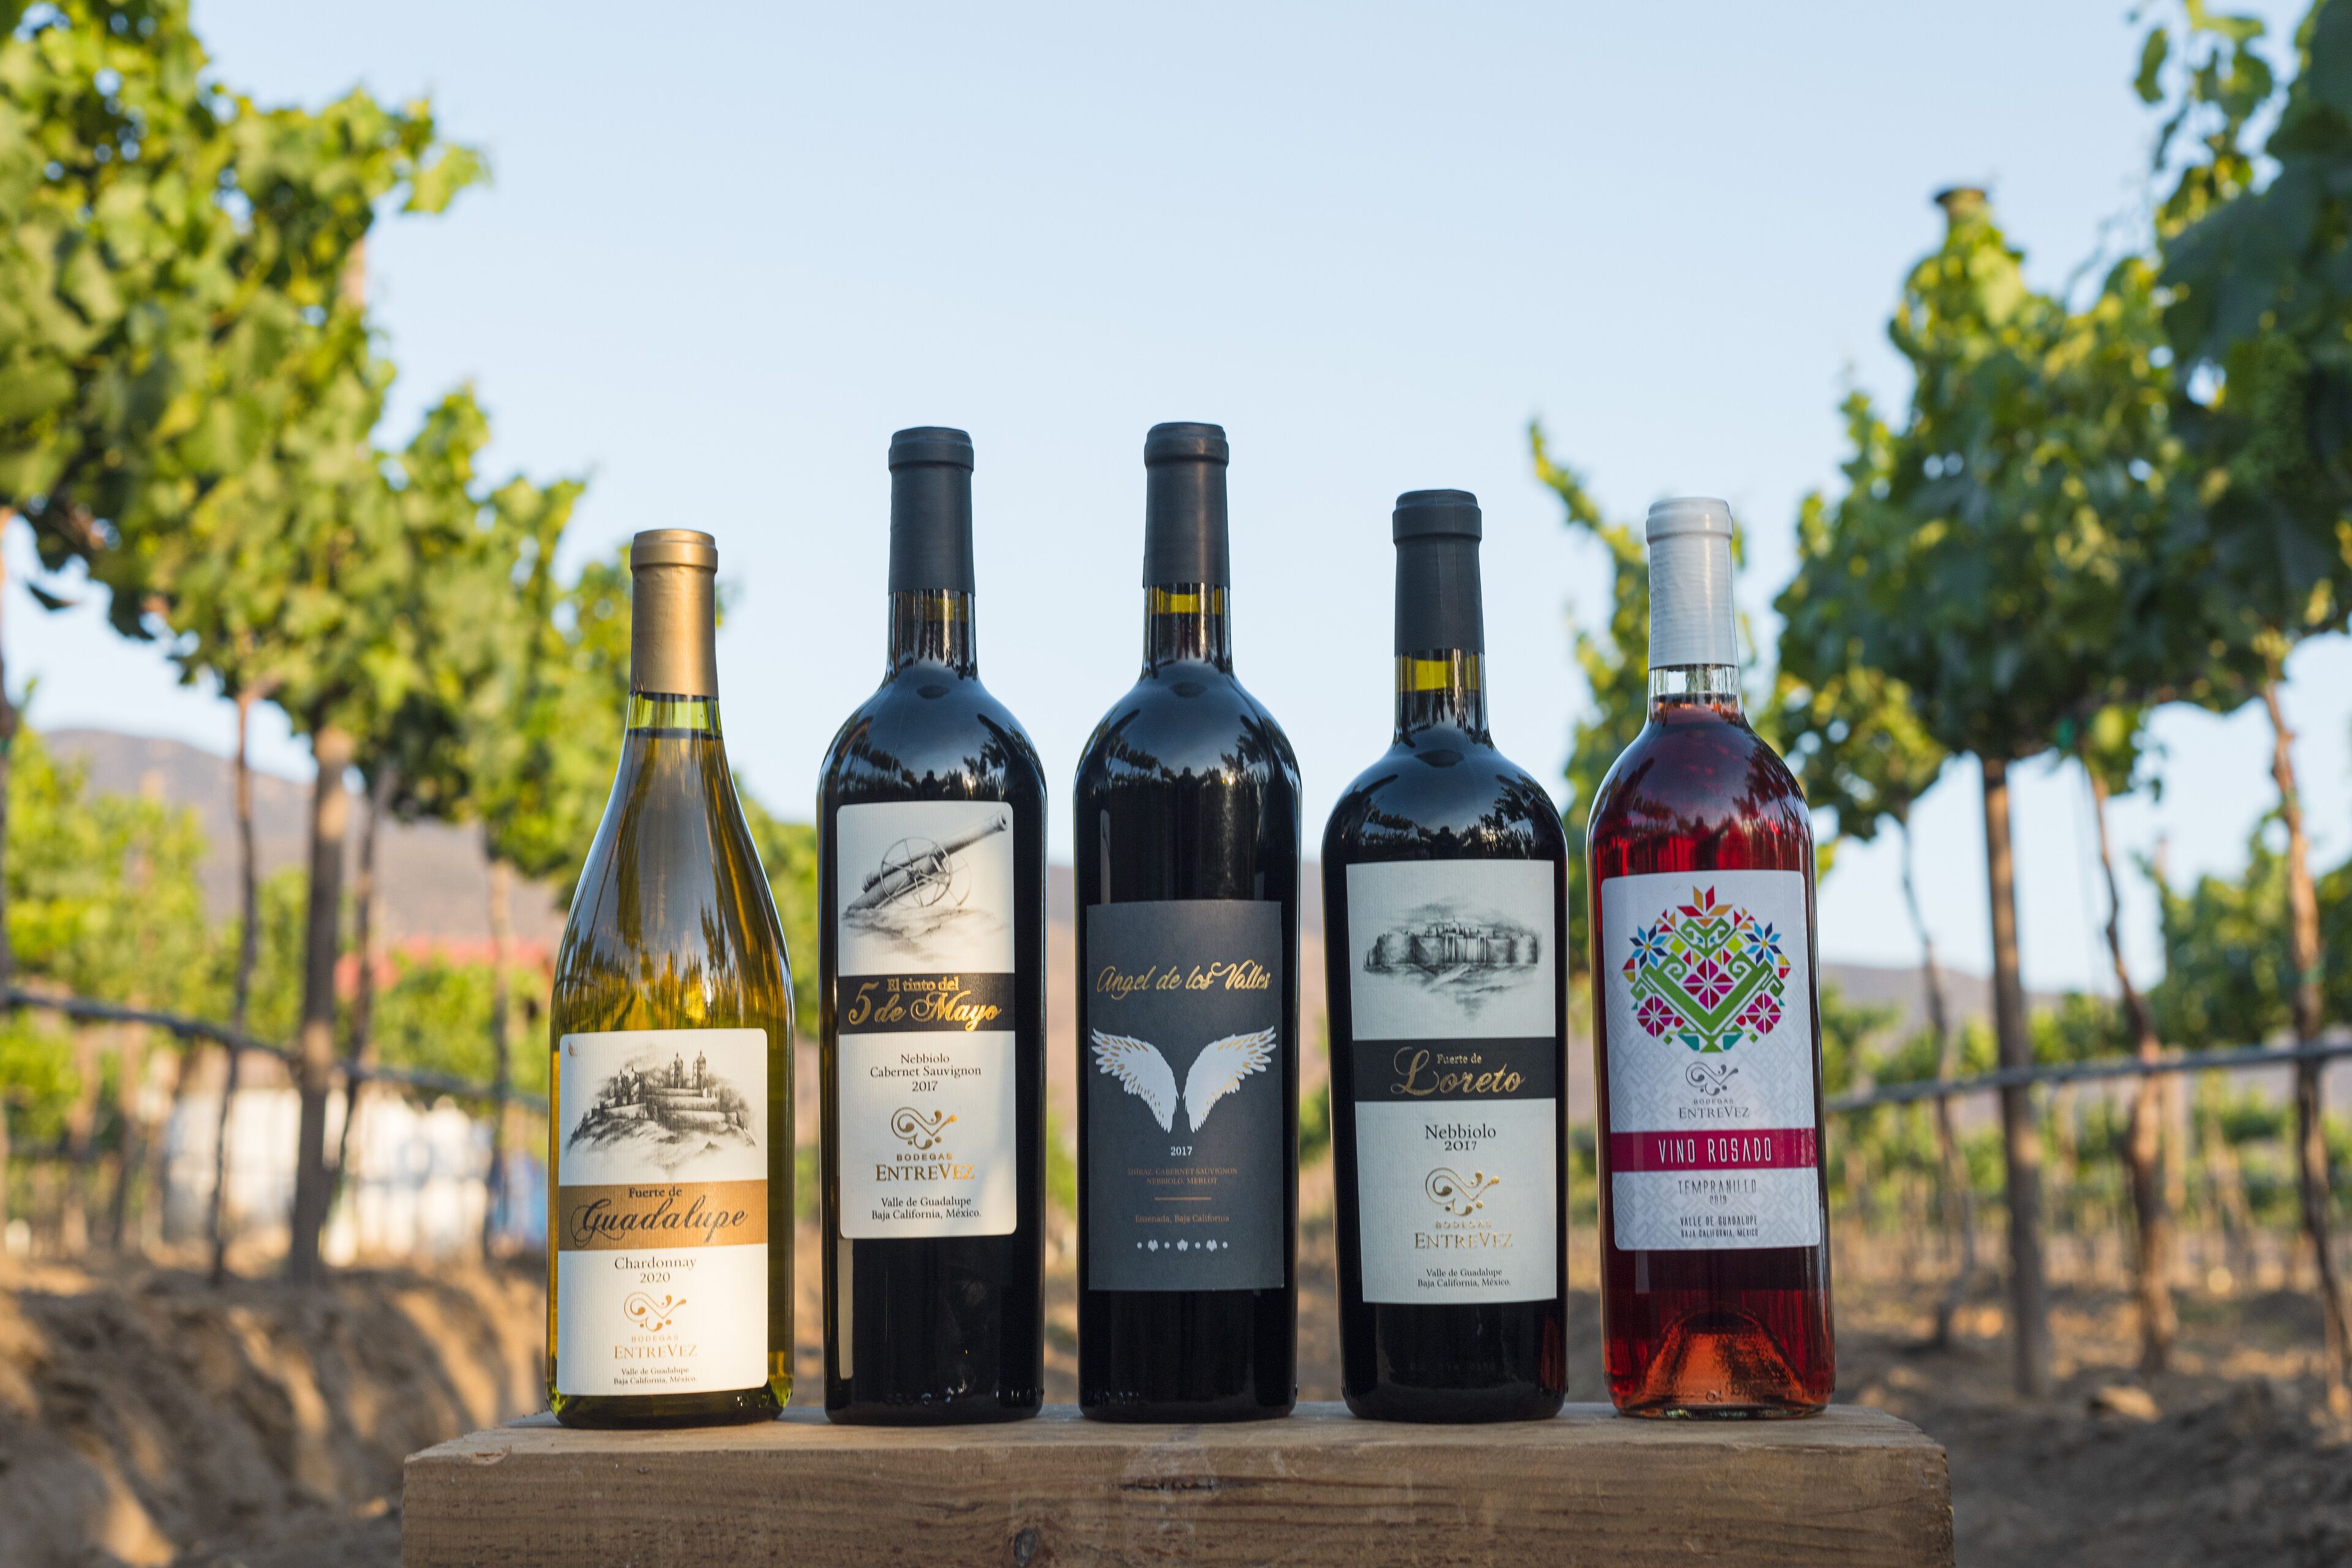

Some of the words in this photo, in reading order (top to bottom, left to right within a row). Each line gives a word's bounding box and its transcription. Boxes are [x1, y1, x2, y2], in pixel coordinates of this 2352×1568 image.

[1156, 965, 1183, 990] de
[1185, 965, 1215, 990] los
[1210, 959, 1272, 990] Valles
[888, 978, 900, 992] El
[903, 978, 936, 992] tinto
[938, 976, 960, 990] del
[848, 981, 879, 1025] 5
[874, 993, 907, 1023] de
[911, 990, 1002, 1032] Mayo
[900, 1053, 950, 1065] Nebbiolo
[1436, 1053, 1468, 1065] Fuerte
[1471, 1052, 1482, 1064] de
[870, 1066, 920, 1078] Cabernet
[923, 1065, 982, 1080] Sauvignon
[1390, 1046, 1526, 1096] Loreto
[911, 1080, 938, 1092] 2017
[1425, 1123, 1496, 1140] Nebbiolo
[1170, 1145, 1193, 1156] 2017
[1444, 1140, 1477, 1152] 2017
[1658, 1139, 1695, 1164] VINO
[1707, 1137, 1772, 1163] ROSADO
[896, 1153, 952, 1162] BODEGAS
[628, 1186, 665, 1199] Fuerte
[668, 1186, 682, 1197] de
[1678, 1178, 1757, 1196] TEMPRANILLO
[881, 1197, 903, 1207] Valle
[907, 1197, 918, 1207] de
[920, 1196, 971, 1207] Guadalupe
[872, 1210, 890, 1222] Baja
[893, 1208, 943, 1219] California,
[1135, 1215, 1172, 1224] Ensenada,
[1174, 1215, 1191, 1224] Baja
[1193, 1213, 1230, 1223] California
[1680, 1216, 1702, 1227] VALLE
[1706, 1216, 1714, 1226] DE
[1718, 1215, 1758, 1226] GUADALUPE
[571, 1195, 748, 1249] Guadalupe
[1436, 1219, 1492, 1229] BODEGAS
[1681, 1229, 1696, 1238] BAJA
[1699, 1228, 1735, 1238] CALIFORNIA,
[614, 1256, 696, 1270] Chardonnay
[640, 1272, 671, 1283] 2020
[1426, 1268, 1446, 1277] Valle
[1449, 1268, 1458, 1277] de
[1460, 1267, 1502, 1278] Guadalupe
[1417, 1280, 1434, 1289] Baja
[1437, 1278, 1479, 1288] California,
[631, 1334, 679, 1343] BODEGAS
[650, 1366, 689, 1376] Guadalupe
[614, 1377, 628, 1386] Baja
[630, 1376, 668, 1384] California,
